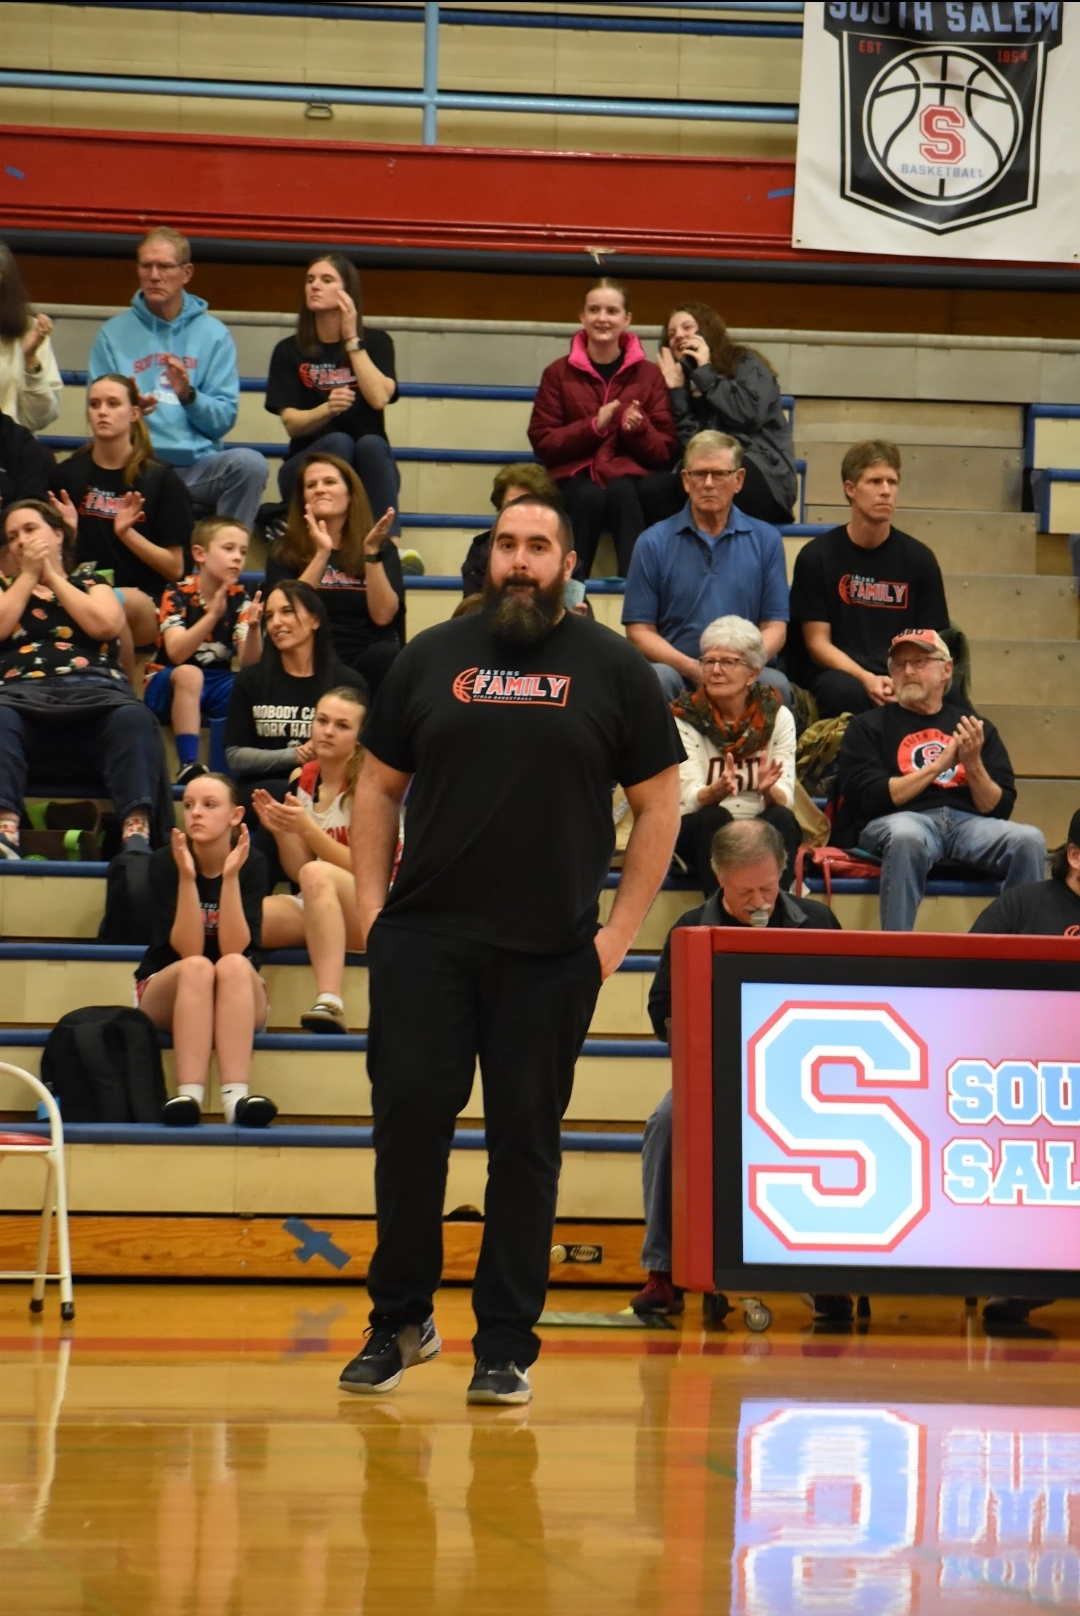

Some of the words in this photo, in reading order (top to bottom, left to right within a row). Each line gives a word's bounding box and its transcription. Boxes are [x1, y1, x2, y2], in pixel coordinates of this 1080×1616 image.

[946, 2, 1058, 33] SALEM
[858, 39, 883, 54] EST
[919, 104, 966, 165] S
[901, 163, 985, 179] BASKETBALL
[309, 368, 357, 385] FAMIL
[850, 580, 906, 603] FAMILY
[473, 675, 567, 698] FAMILY
[252, 704, 299, 719] NOBODY
[946, 1058, 1080, 1128] SOU
[747, 1000, 931, 1253] S
[942, 1137, 1080, 1207] SAL
